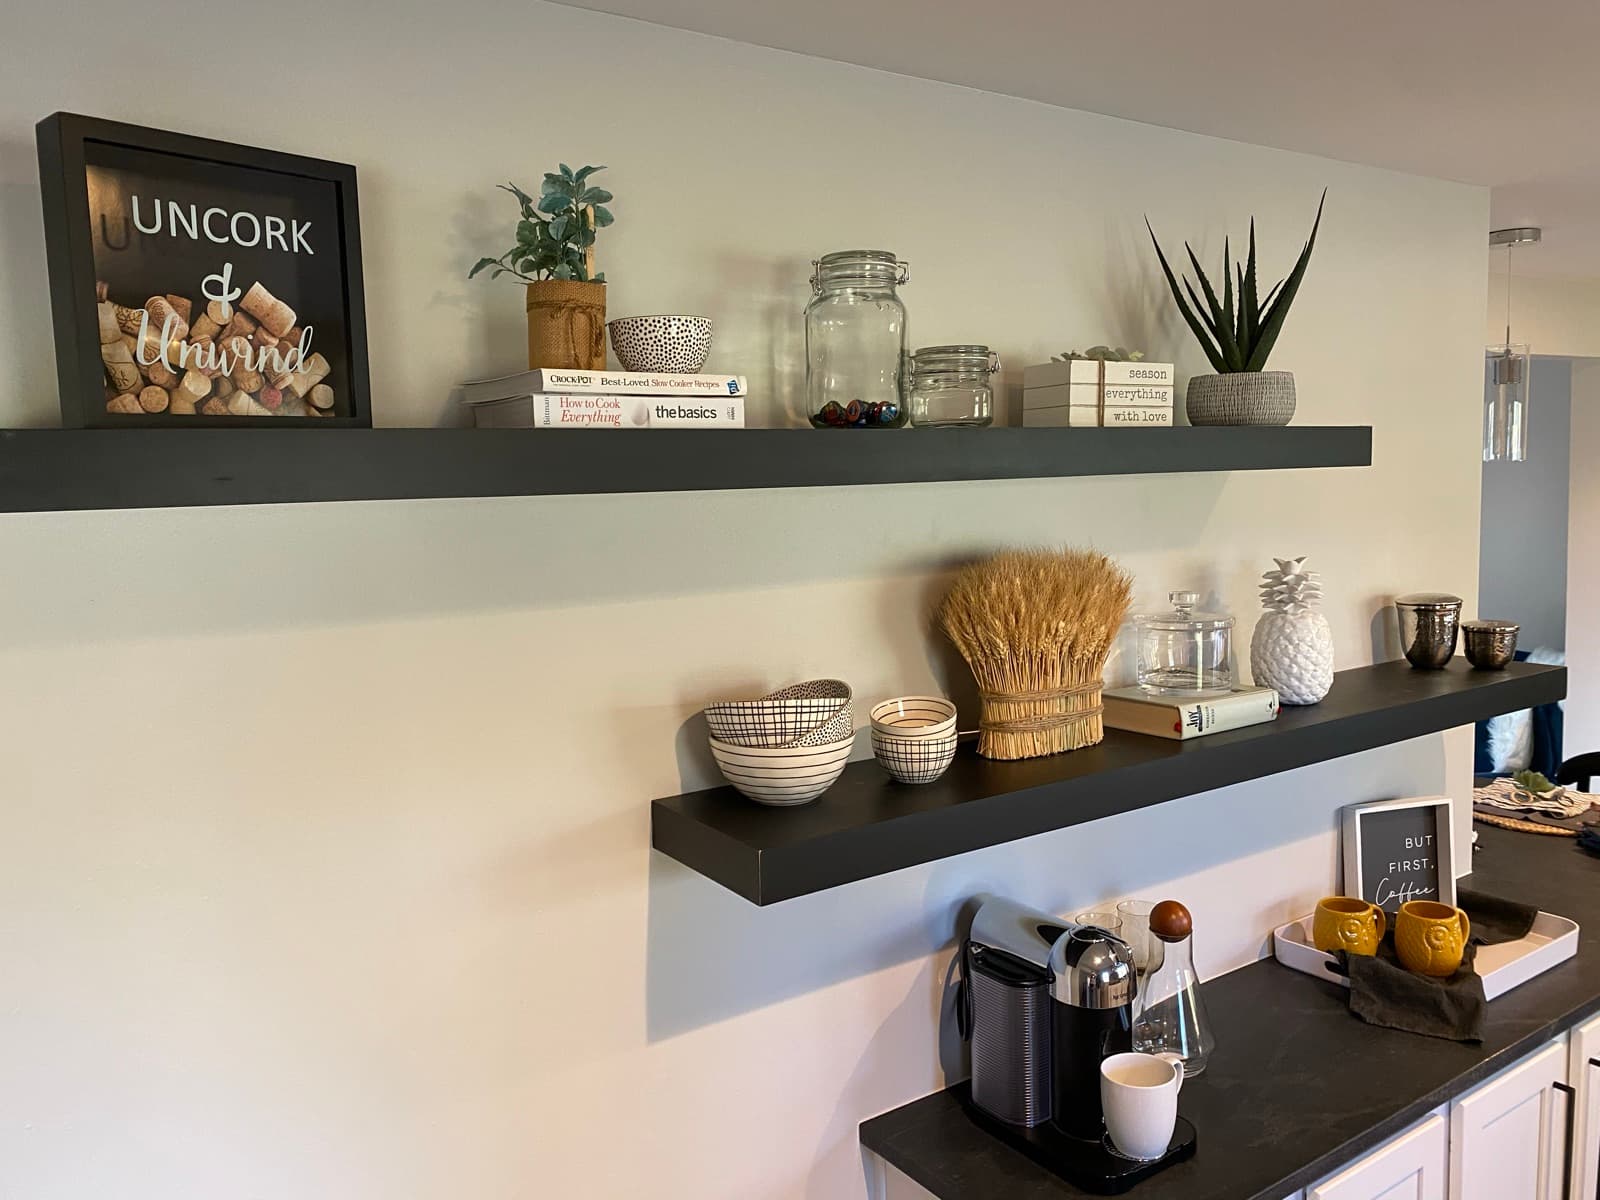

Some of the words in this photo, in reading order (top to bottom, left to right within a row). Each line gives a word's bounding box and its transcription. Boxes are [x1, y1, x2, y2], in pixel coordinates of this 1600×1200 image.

[131, 195, 314, 255] UNCORK
[201, 262, 241, 318] &
[134, 308, 313, 377] Unwind
[1128, 369, 1167, 380] season
[601, 377, 650, 388] Best-Loved
[651, 379, 668, 387] Slow
[669, 379, 693, 388] Cooker
[694, 380, 720, 390] Recipes
[1105, 388, 1168, 401] everything
[559, 397, 583, 409] How
[585, 398, 595, 409] to
[595, 397, 621, 409] Cook
[560, 409, 621, 427] Everything
[655, 405, 677, 419] the
[678, 405, 717, 419] basics
[1113, 411, 1139, 422] with
[1141, 411, 1167, 422] love
[1405, 835, 1433, 849] BUT
[1375, 877, 1435, 906] Coffee
